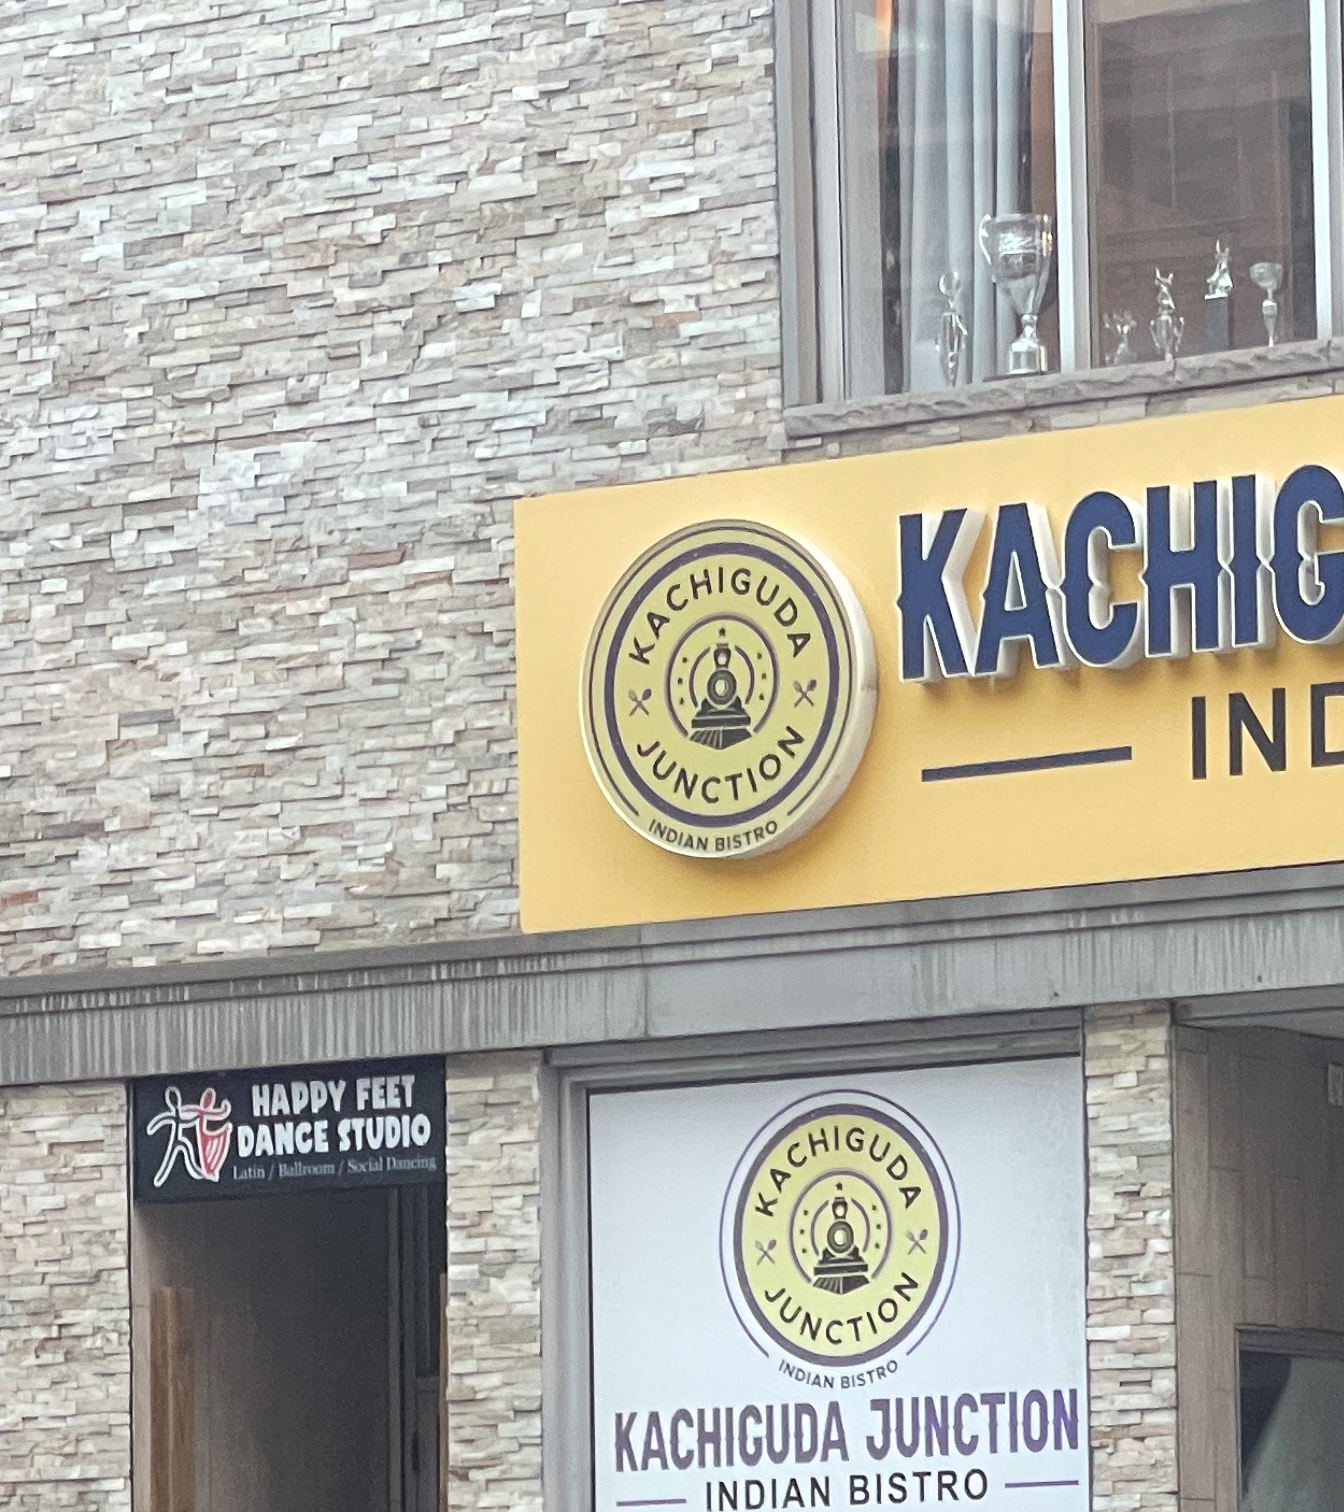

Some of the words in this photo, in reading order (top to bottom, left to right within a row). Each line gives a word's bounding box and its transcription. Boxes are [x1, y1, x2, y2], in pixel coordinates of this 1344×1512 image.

[628, 566, 811, 665] KACHIGUDA
[637, 725, 805, 804] JUNCTION
[649, 819, 708, 851] INDIAN
[715, 820, 778, 851] BISTRO
[251, 1080, 347, 1117] HAPPY
[356, 1074, 415, 1111] FEET
[237, 1120, 328, 1158] DANCE
[337, 1113, 431, 1152] STUDIO
[233, 1166, 265, 1180] Latin
[279, 1161, 335, 1178] Ballroom
[347, 1156, 382, 1173] Social
[386, 1154, 437, 1172] Dancing
[755, 1125, 922, 1217] KACHIGUDA
[764, 1272, 919, 1346] JUNCTION
[779, 1359, 835, 1389] INDIAN
[840, 1360, 898, 1389] BISTRO
[615, 1400, 849, 1474] KACHIGUDA
[866, 1388, 1079, 1461] JUNCTION
[705, 1475, 831, 1512] INDIAN
[850, 1468, 988, 1506] BISTRO
